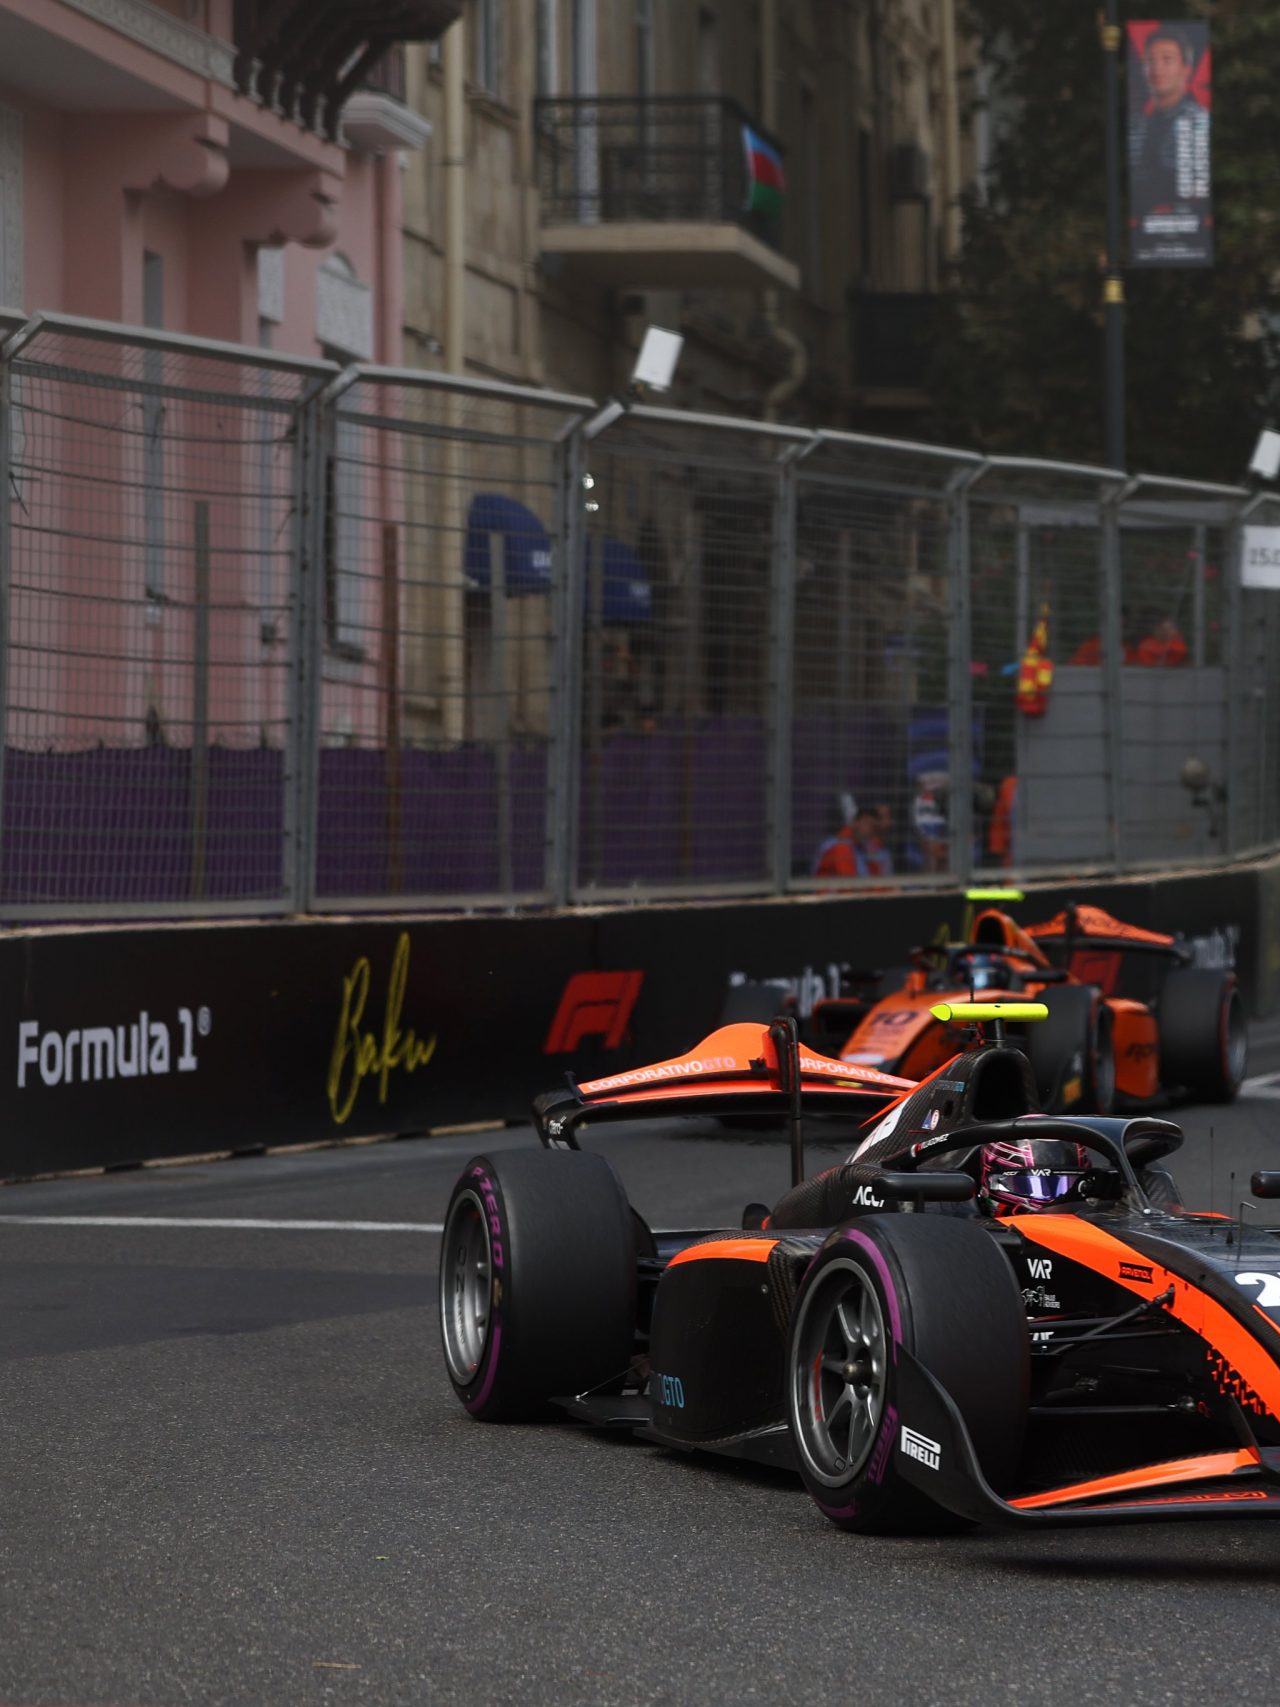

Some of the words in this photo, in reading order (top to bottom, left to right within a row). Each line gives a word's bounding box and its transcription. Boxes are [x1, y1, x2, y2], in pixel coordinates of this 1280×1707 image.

[799, 1057, 895, 1083] ORPORATIVO
[1030, 1168, 1051, 1177] VAR
[1026, 1258, 1053, 1280] VAR
[900, 1424, 942, 1471] PIRELLI
